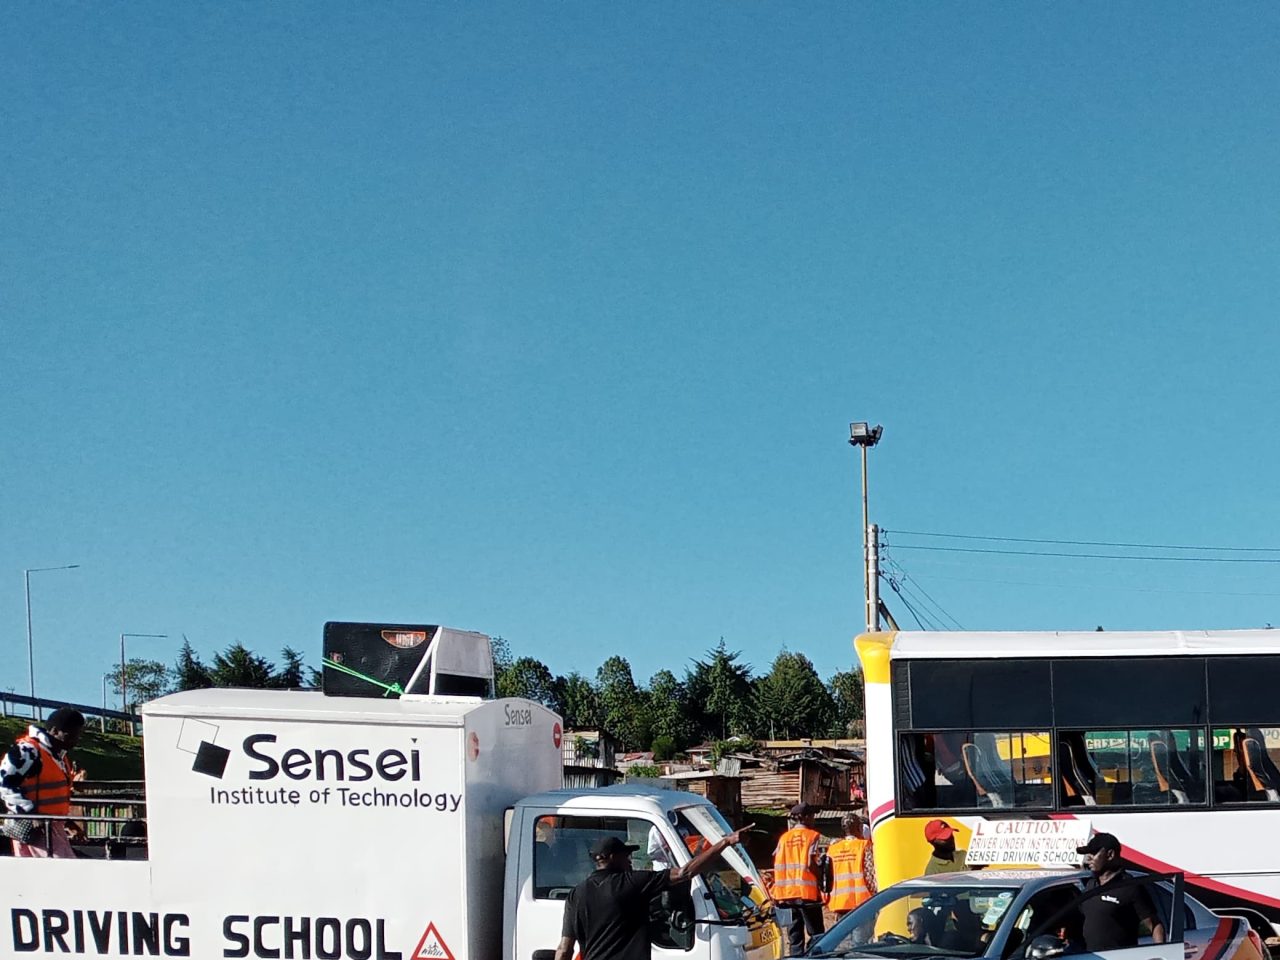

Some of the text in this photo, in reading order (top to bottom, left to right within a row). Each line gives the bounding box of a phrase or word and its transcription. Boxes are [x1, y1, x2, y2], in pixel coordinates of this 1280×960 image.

[504, 704, 532, 726] Sensei
[242, 733, 421, 782] Sensei
[210, 786, 463, 812] Institute of Technology
[976, 821, 1067, 836] L CAUTION!
[970, 837, 997, 850] DRIVER
[999, 837, 1027, 850] UNDER
[967, 850, 1080, 863] SENSEI DRIVING SCHOOL
[11, 907, 190, 957] DRIVING
